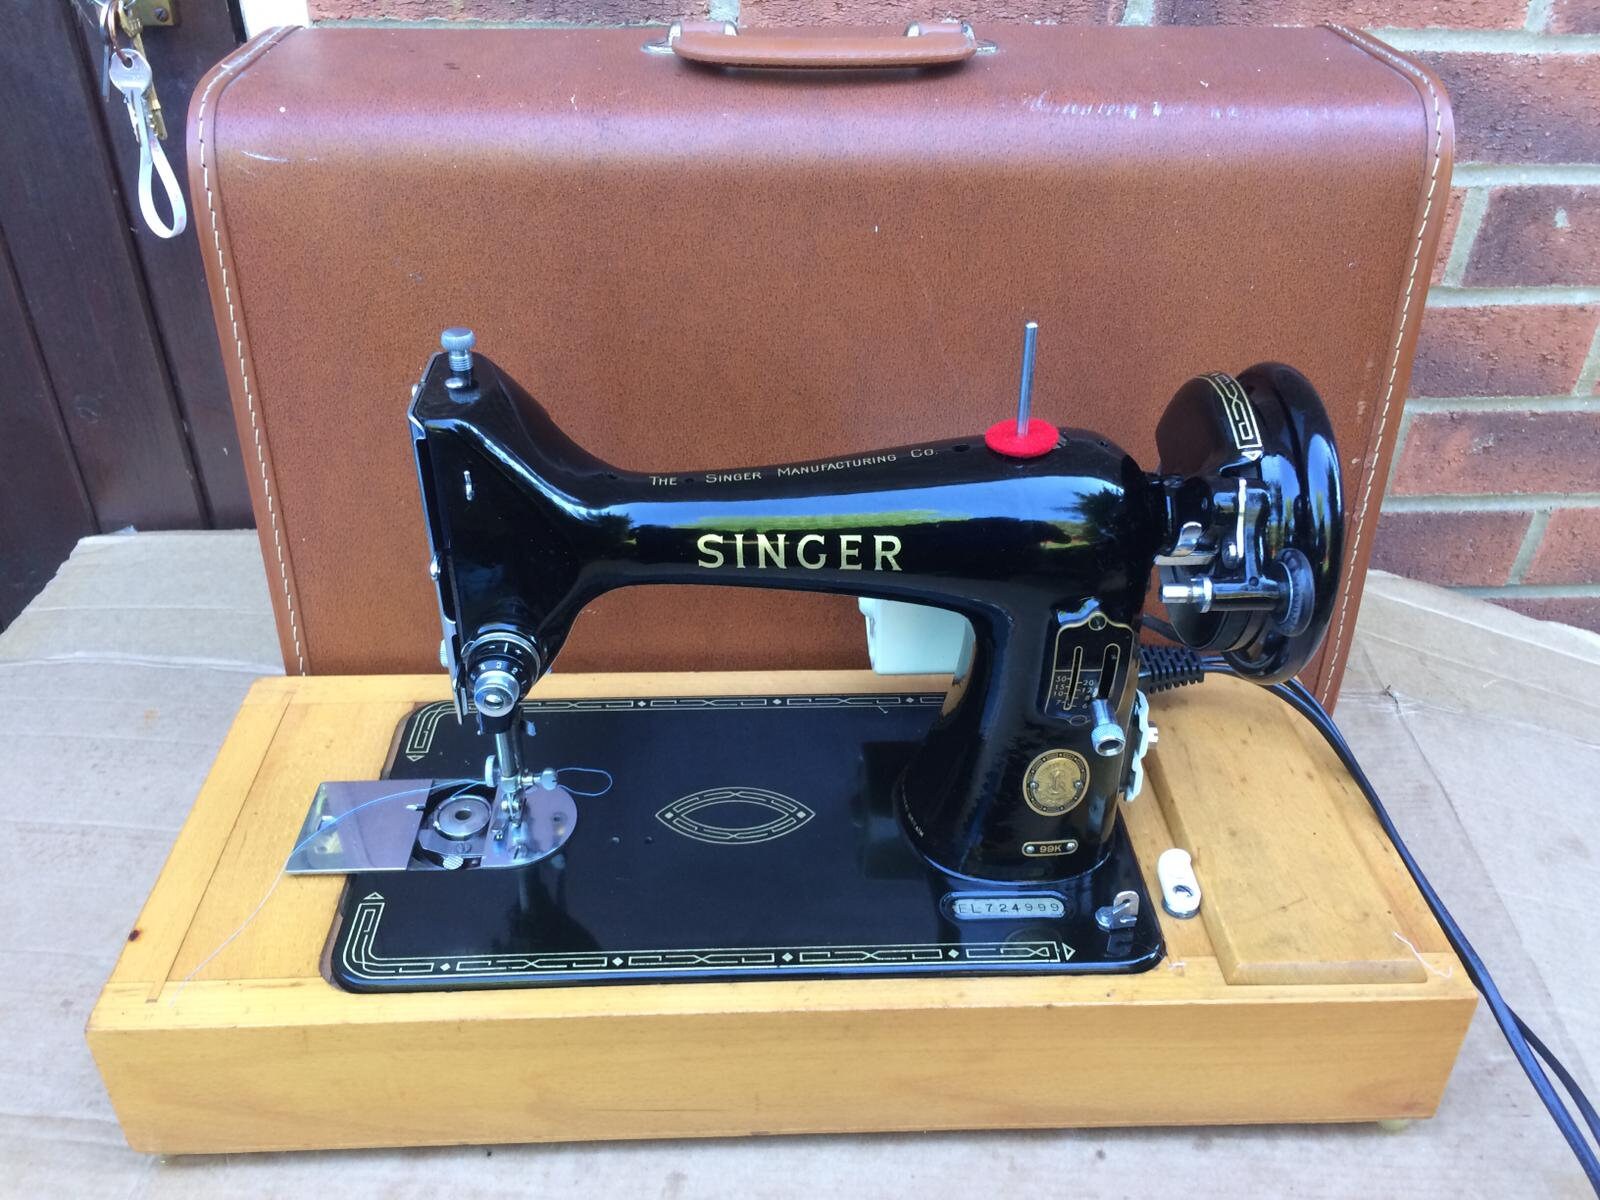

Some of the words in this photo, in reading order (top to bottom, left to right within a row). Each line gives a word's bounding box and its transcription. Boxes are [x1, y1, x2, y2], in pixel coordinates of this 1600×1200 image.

[705, 471, 762, 484] SINGER
[777, 453, 897, 477] MANUFACTURING
[696, 533, 903, 572] SINGER
[511, 667, 518, 675] 2
[1039, 844, 1062, 853] 99K
[958, 903, 1059, 914] EL724999
